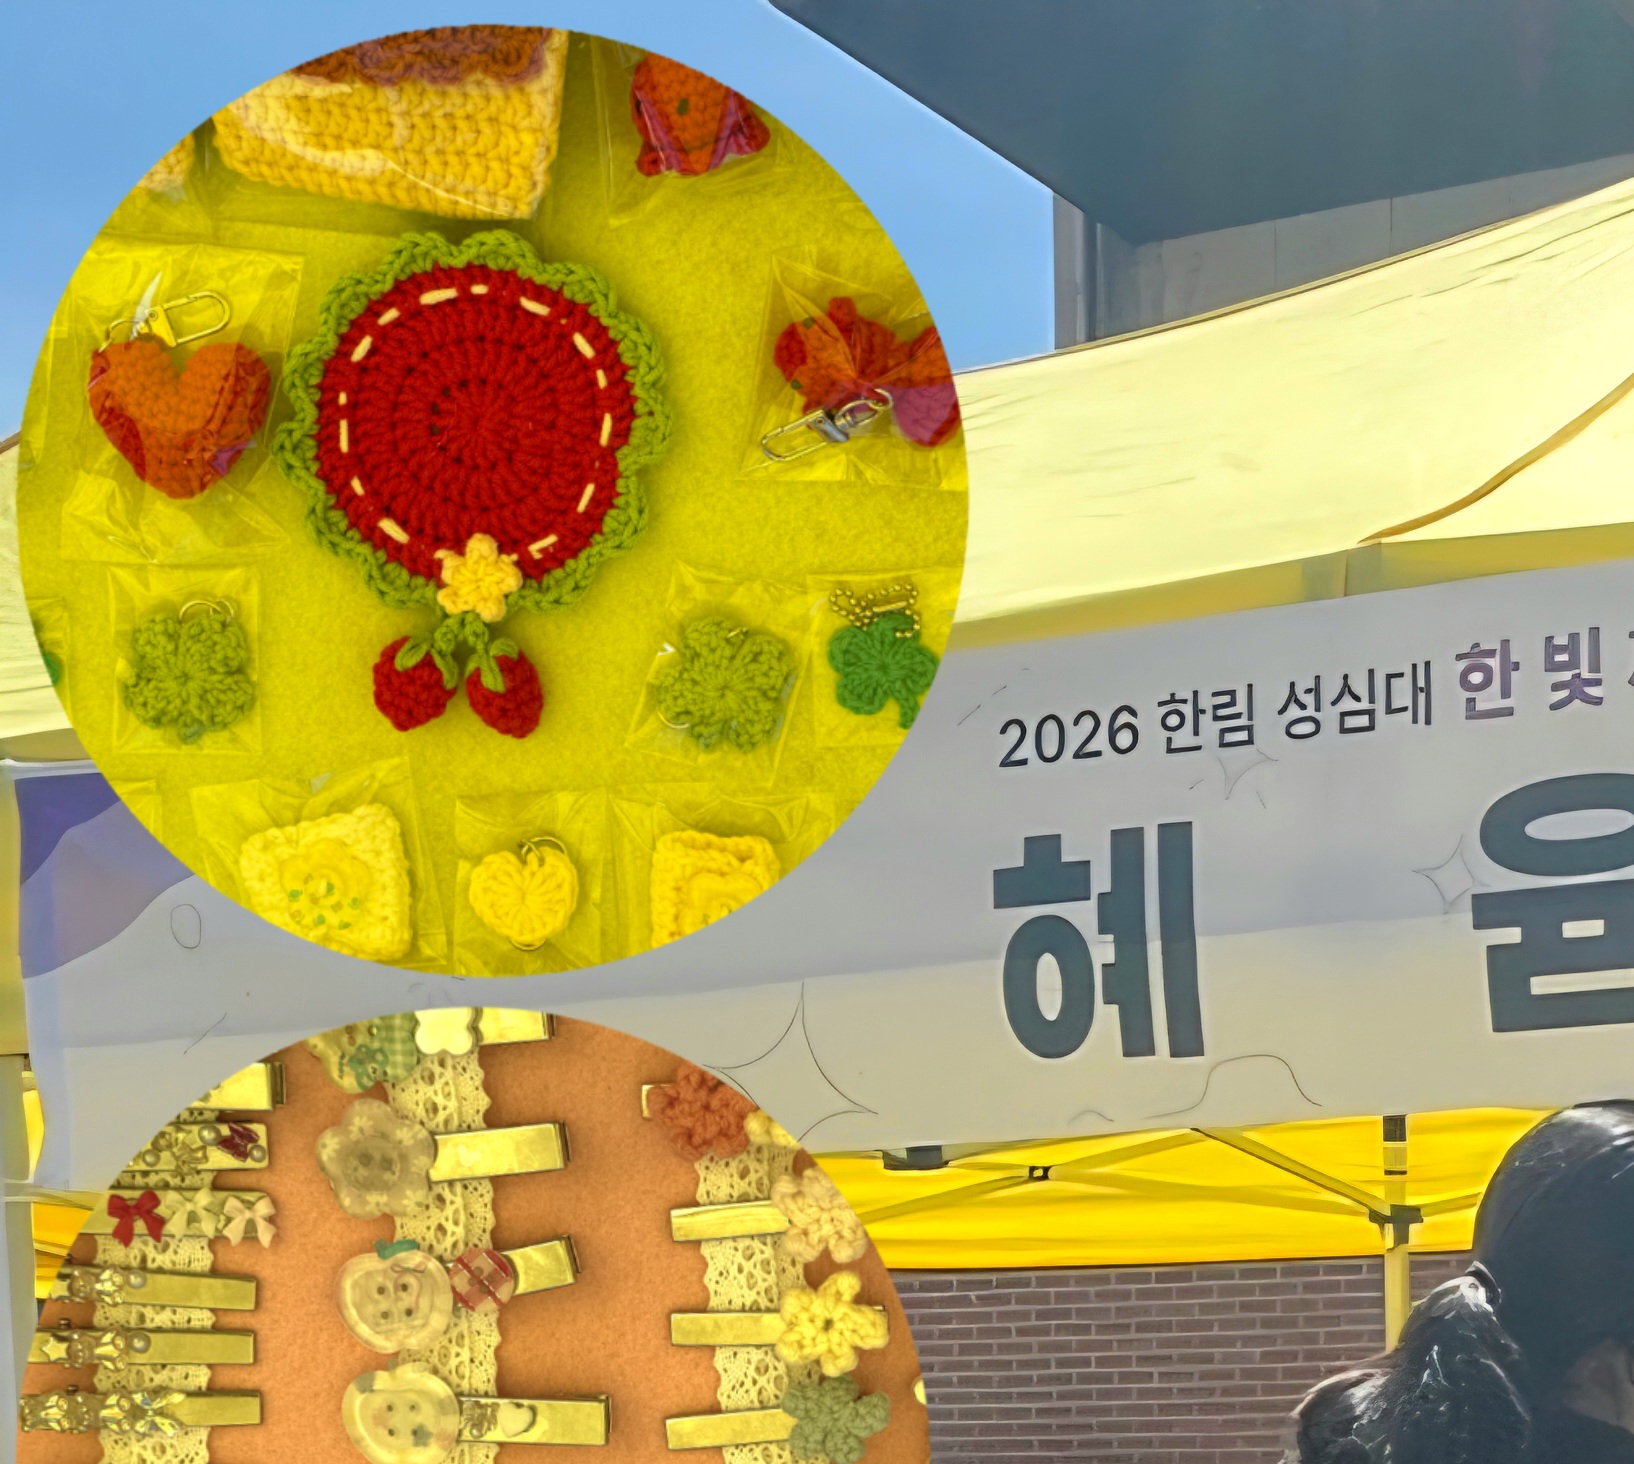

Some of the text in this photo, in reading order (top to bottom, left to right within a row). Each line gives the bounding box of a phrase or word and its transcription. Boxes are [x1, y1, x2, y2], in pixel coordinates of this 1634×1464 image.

[999, 704, 1140, 768] 2026
[1156, 688, 1255, 755] 한림
[1277, 660, 1432, 740] 성심대
